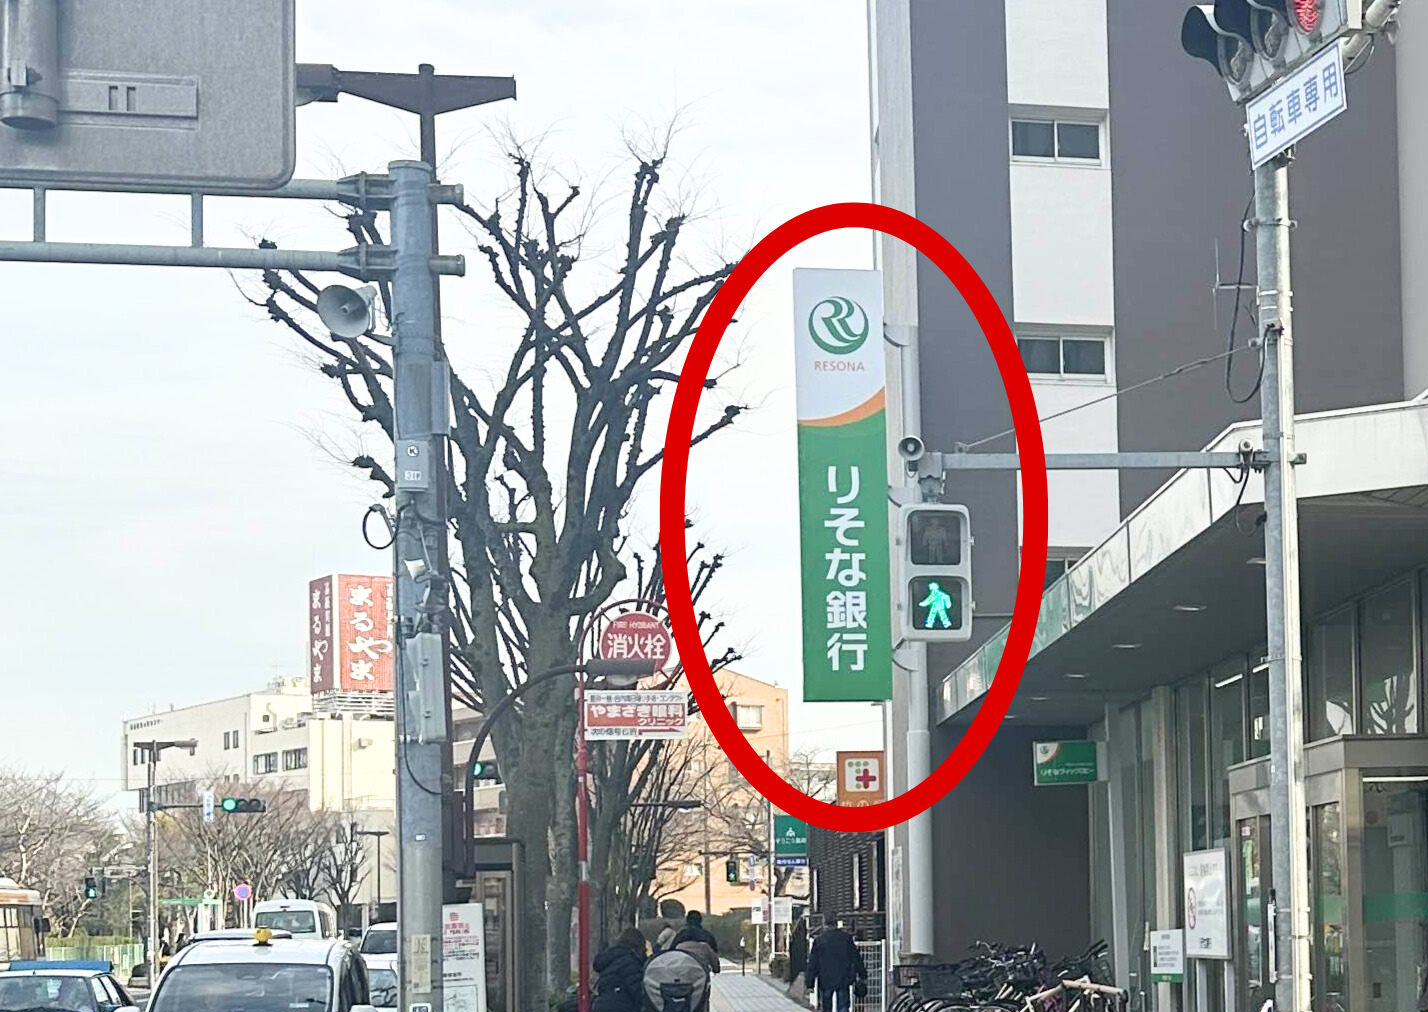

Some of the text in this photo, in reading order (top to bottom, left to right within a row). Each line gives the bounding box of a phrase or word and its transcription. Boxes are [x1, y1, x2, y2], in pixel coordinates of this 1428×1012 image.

[1253, 62, 1339, 149] 自転車専用
[814, 360, 866, 372] RESONA
[824, 465, 868, 672] りそな銀行
[312, 588, 329, 683] まるやま
[348, 584, 393, 681] まるやま
[607, 632, 667, 660] 消火栓
[589, 704, 684, 719] やまざき眼科
[637, 718, 684, 727] クリニック
